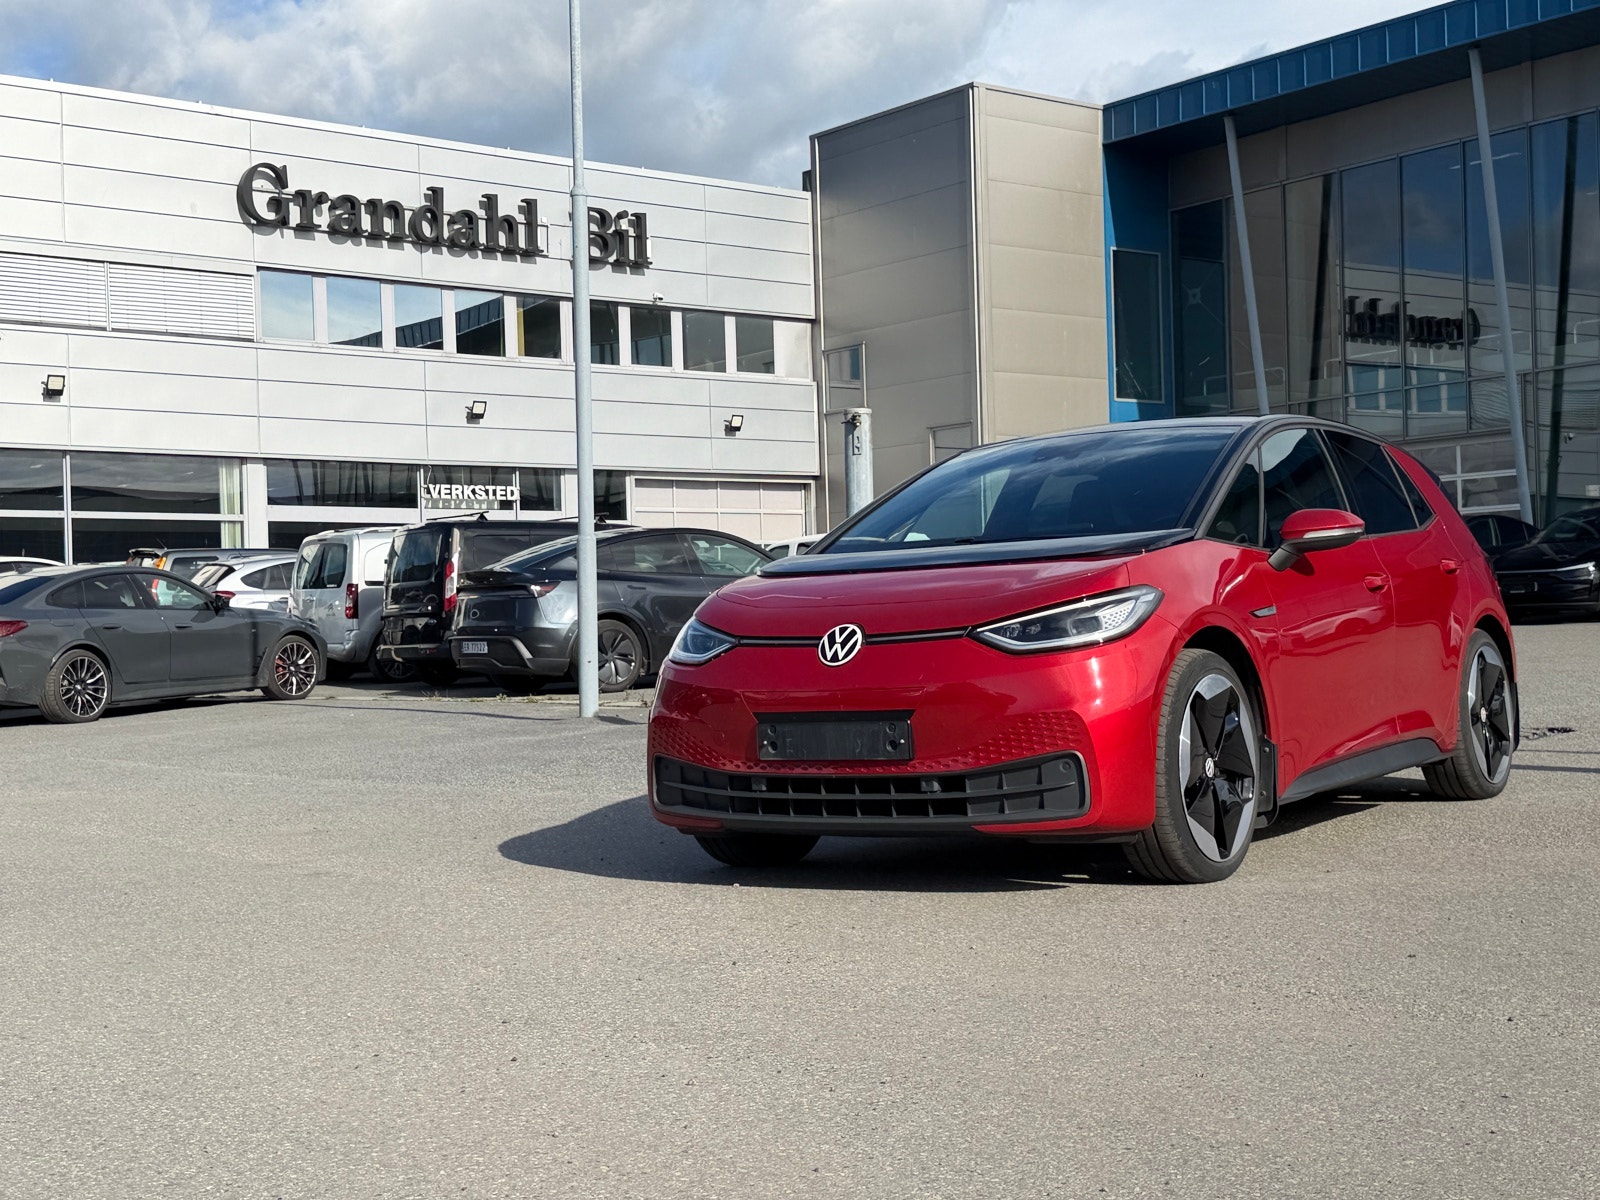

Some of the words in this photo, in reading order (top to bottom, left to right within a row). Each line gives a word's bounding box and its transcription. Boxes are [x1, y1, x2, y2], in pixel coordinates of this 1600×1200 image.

[237, 163, 543, 256] Grandahl
[586, 206, 652, 268] Bil
[428, 484, 518, 500] VERKSTED
